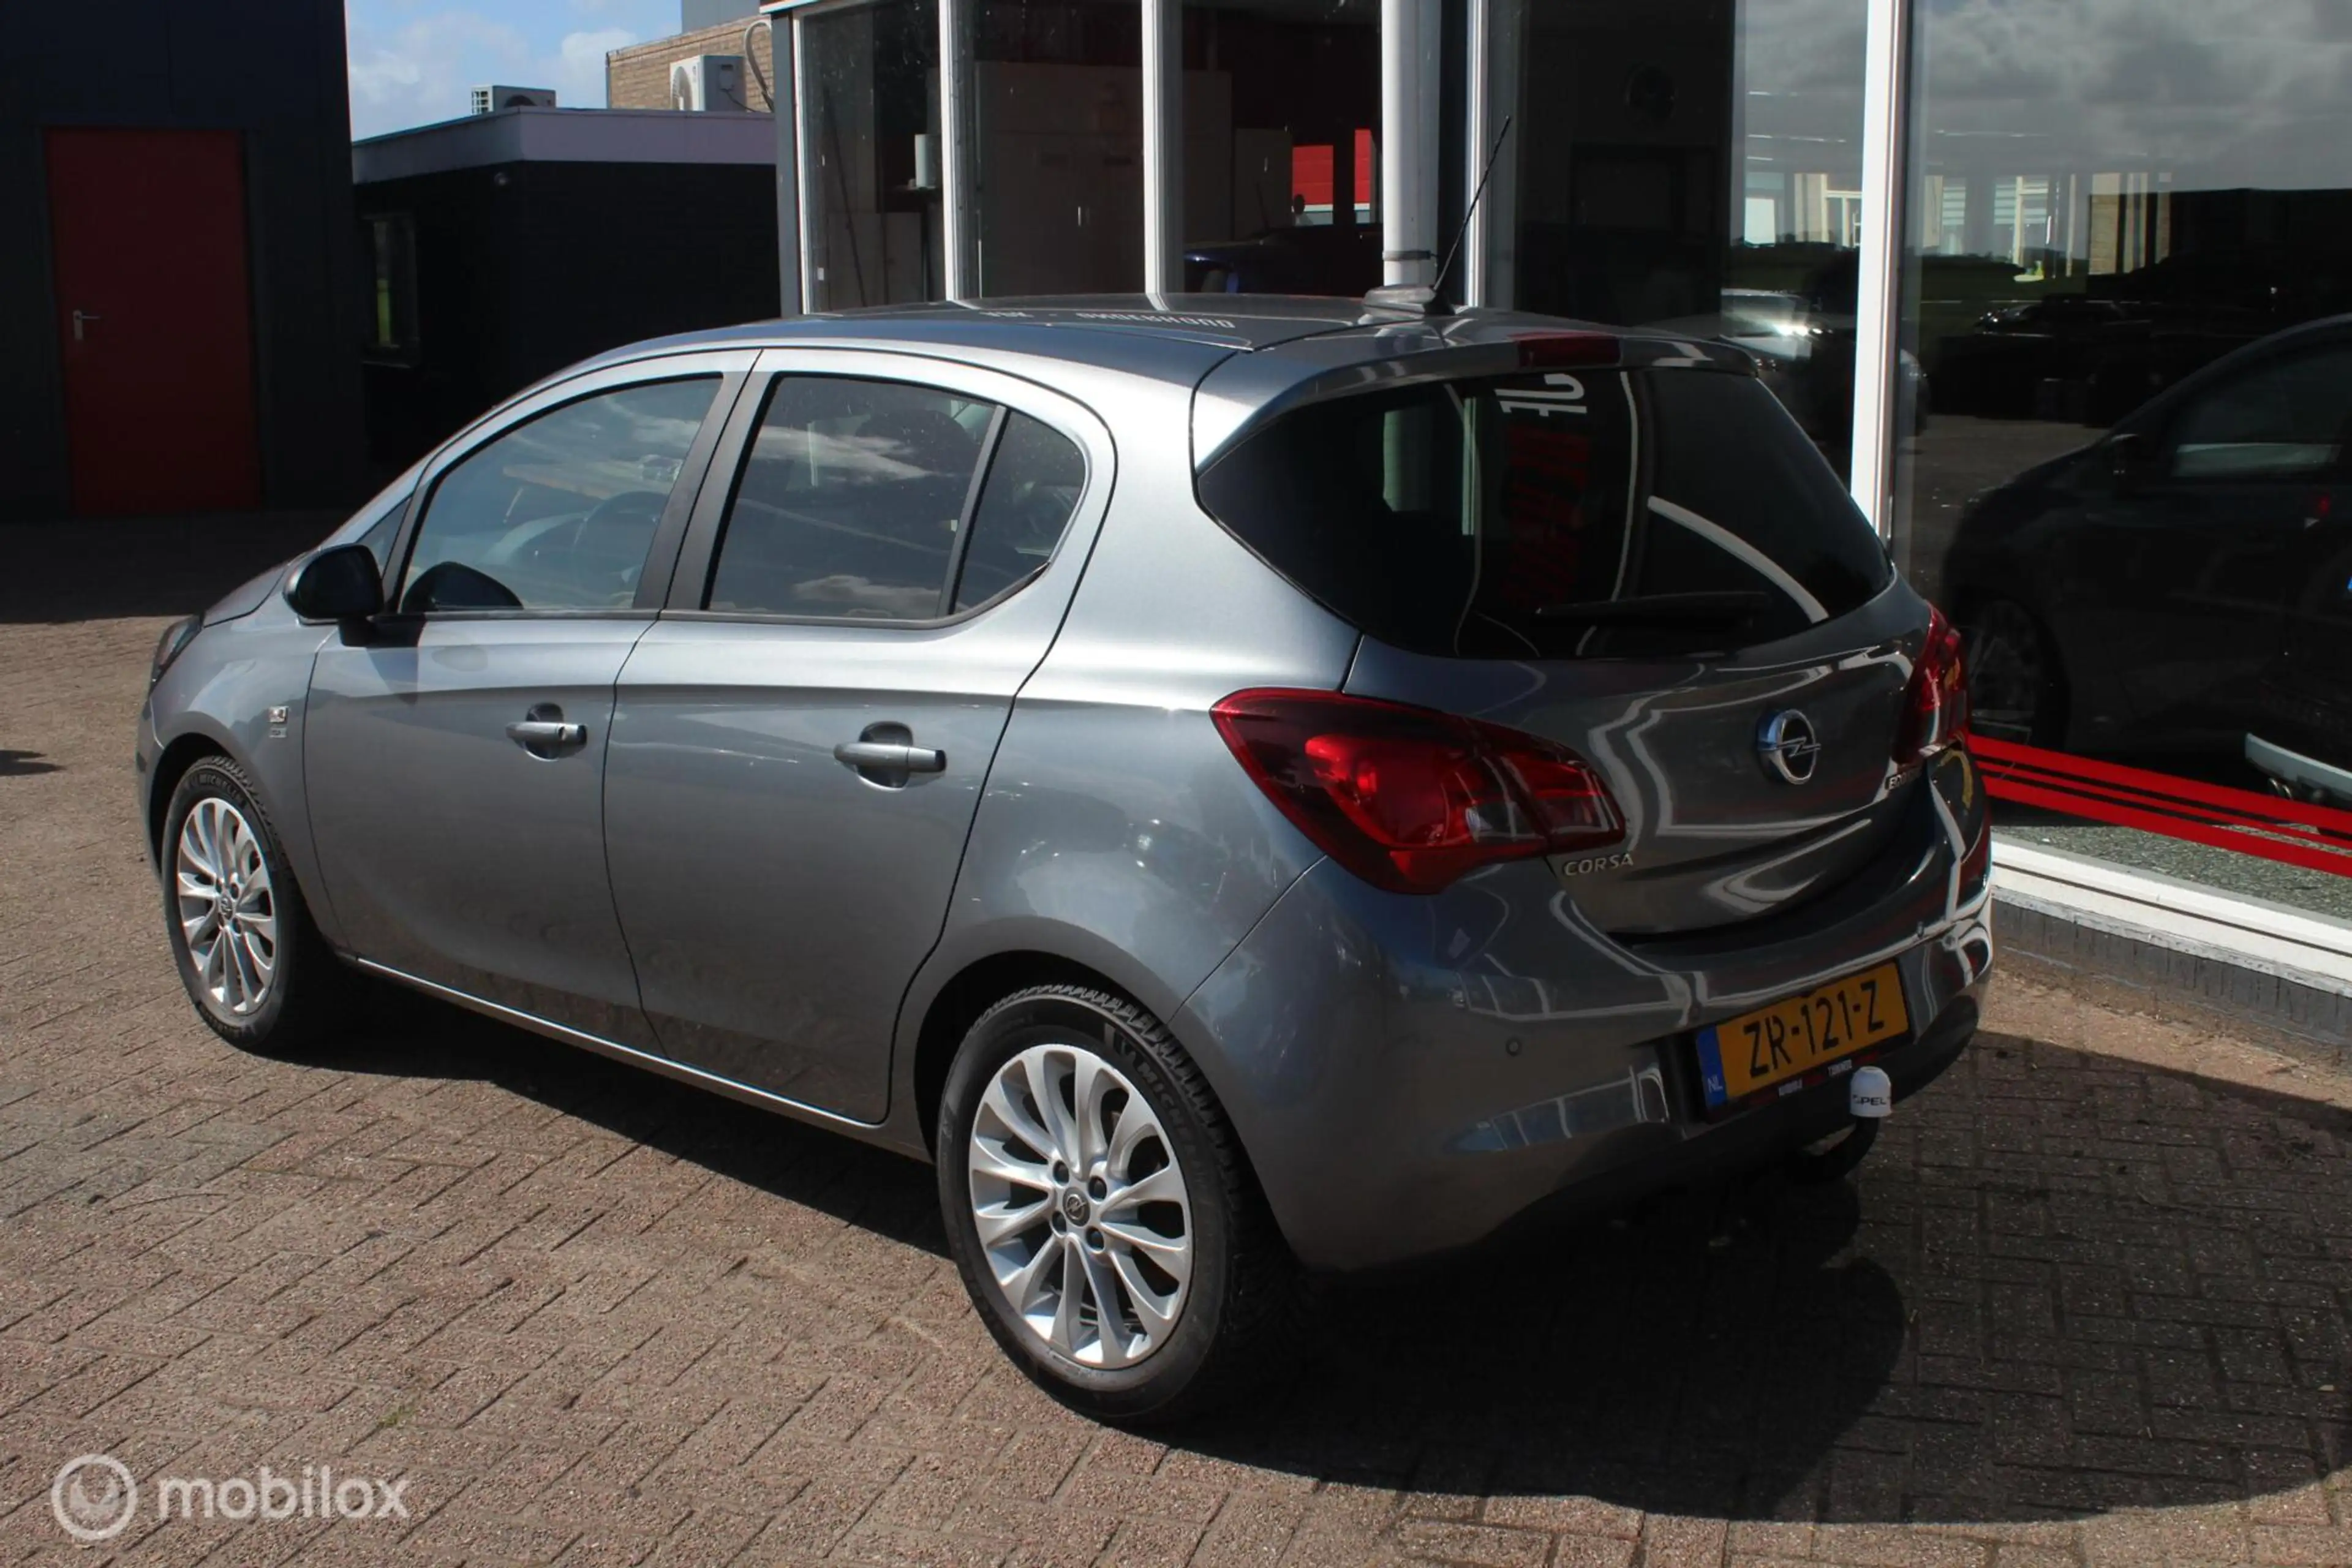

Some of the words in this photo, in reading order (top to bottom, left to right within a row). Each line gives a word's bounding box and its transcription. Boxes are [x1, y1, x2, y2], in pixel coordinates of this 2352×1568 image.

[1564, 853, 1634, 876] CORSA
[1743, 980, 1885, 1078] ZR-121-Z
[1708, 1076, 1724, 1093] NL
